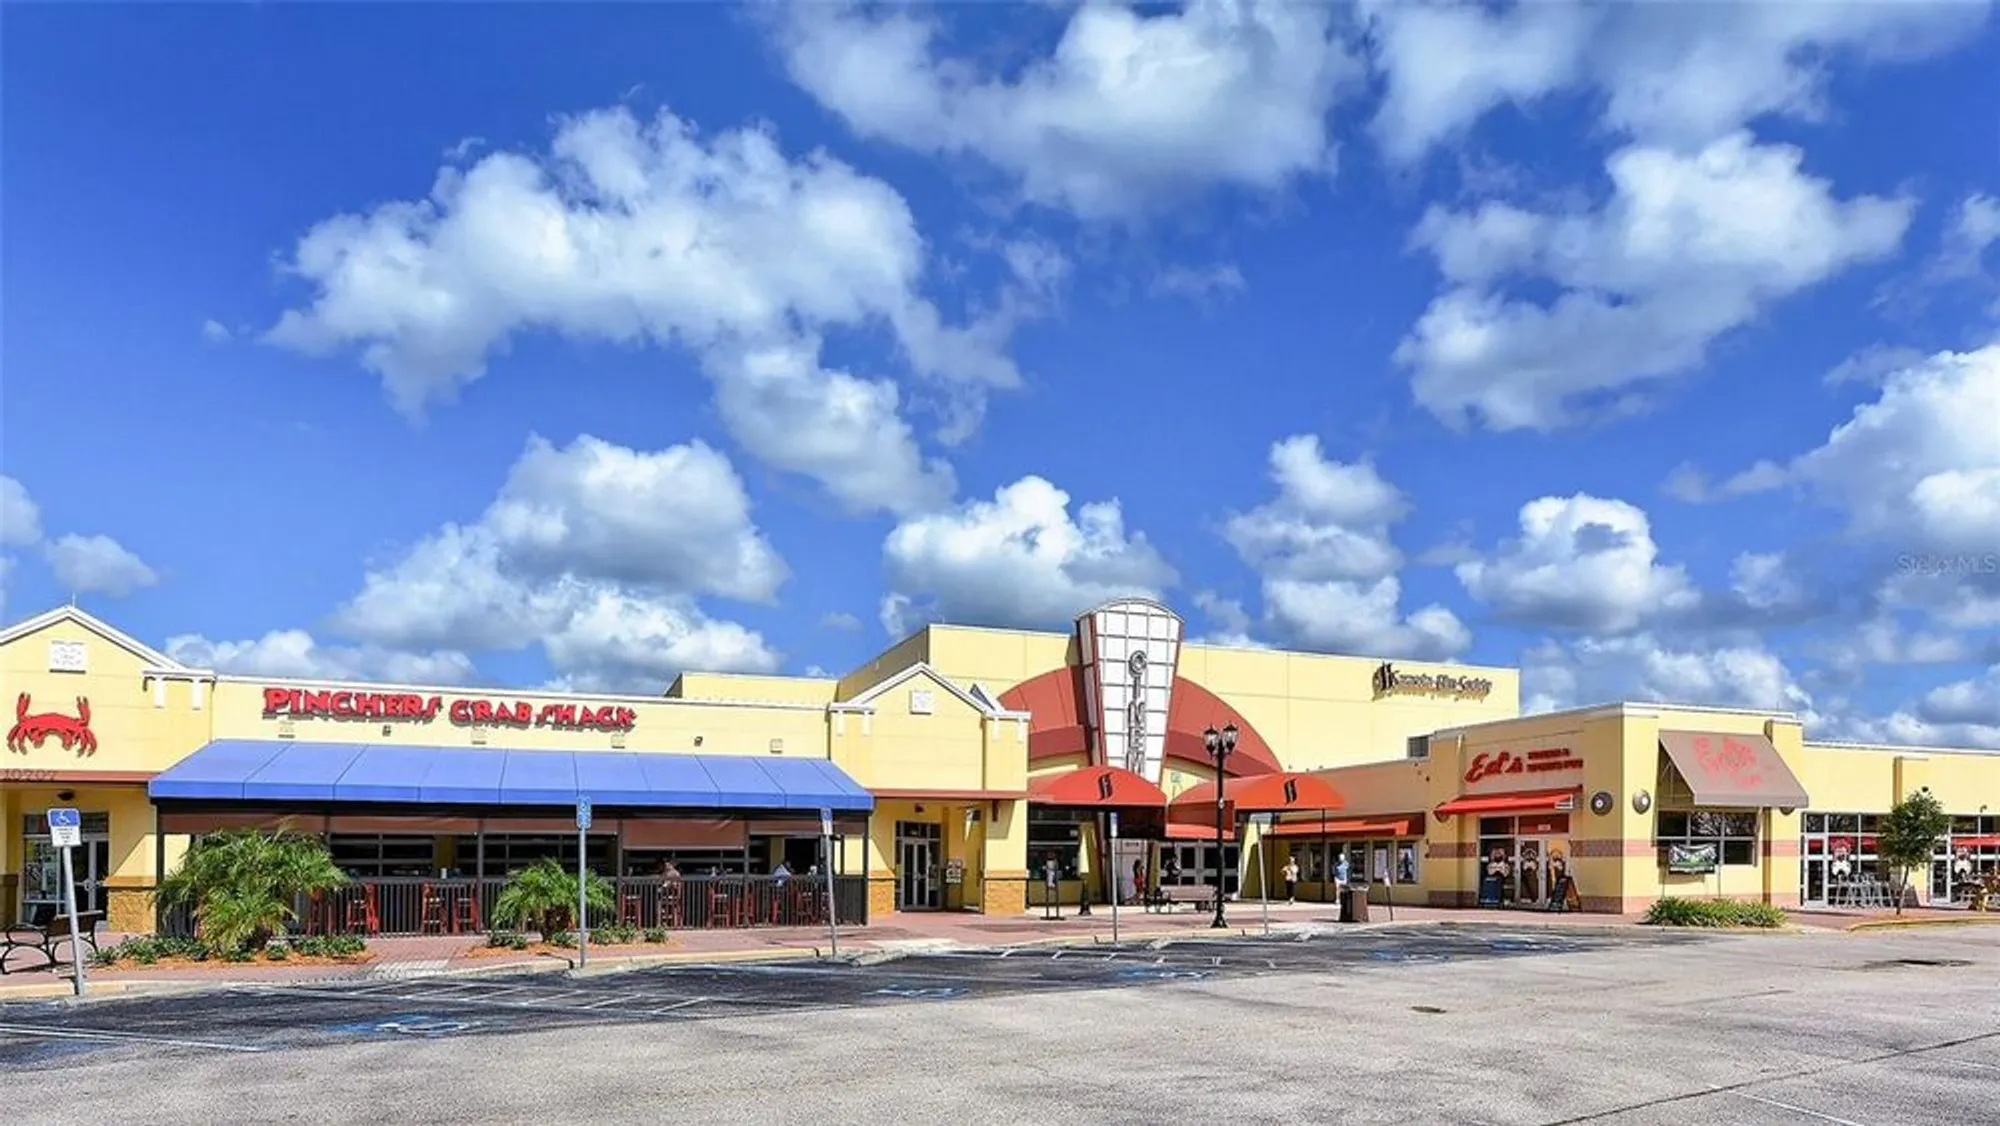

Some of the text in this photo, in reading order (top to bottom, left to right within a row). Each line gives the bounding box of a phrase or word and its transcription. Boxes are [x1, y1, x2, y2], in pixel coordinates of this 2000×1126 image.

[263, 687, 638, 731] PINCHERS CRAB SHACK
[1464, 751, 1523, 782] Ed's
